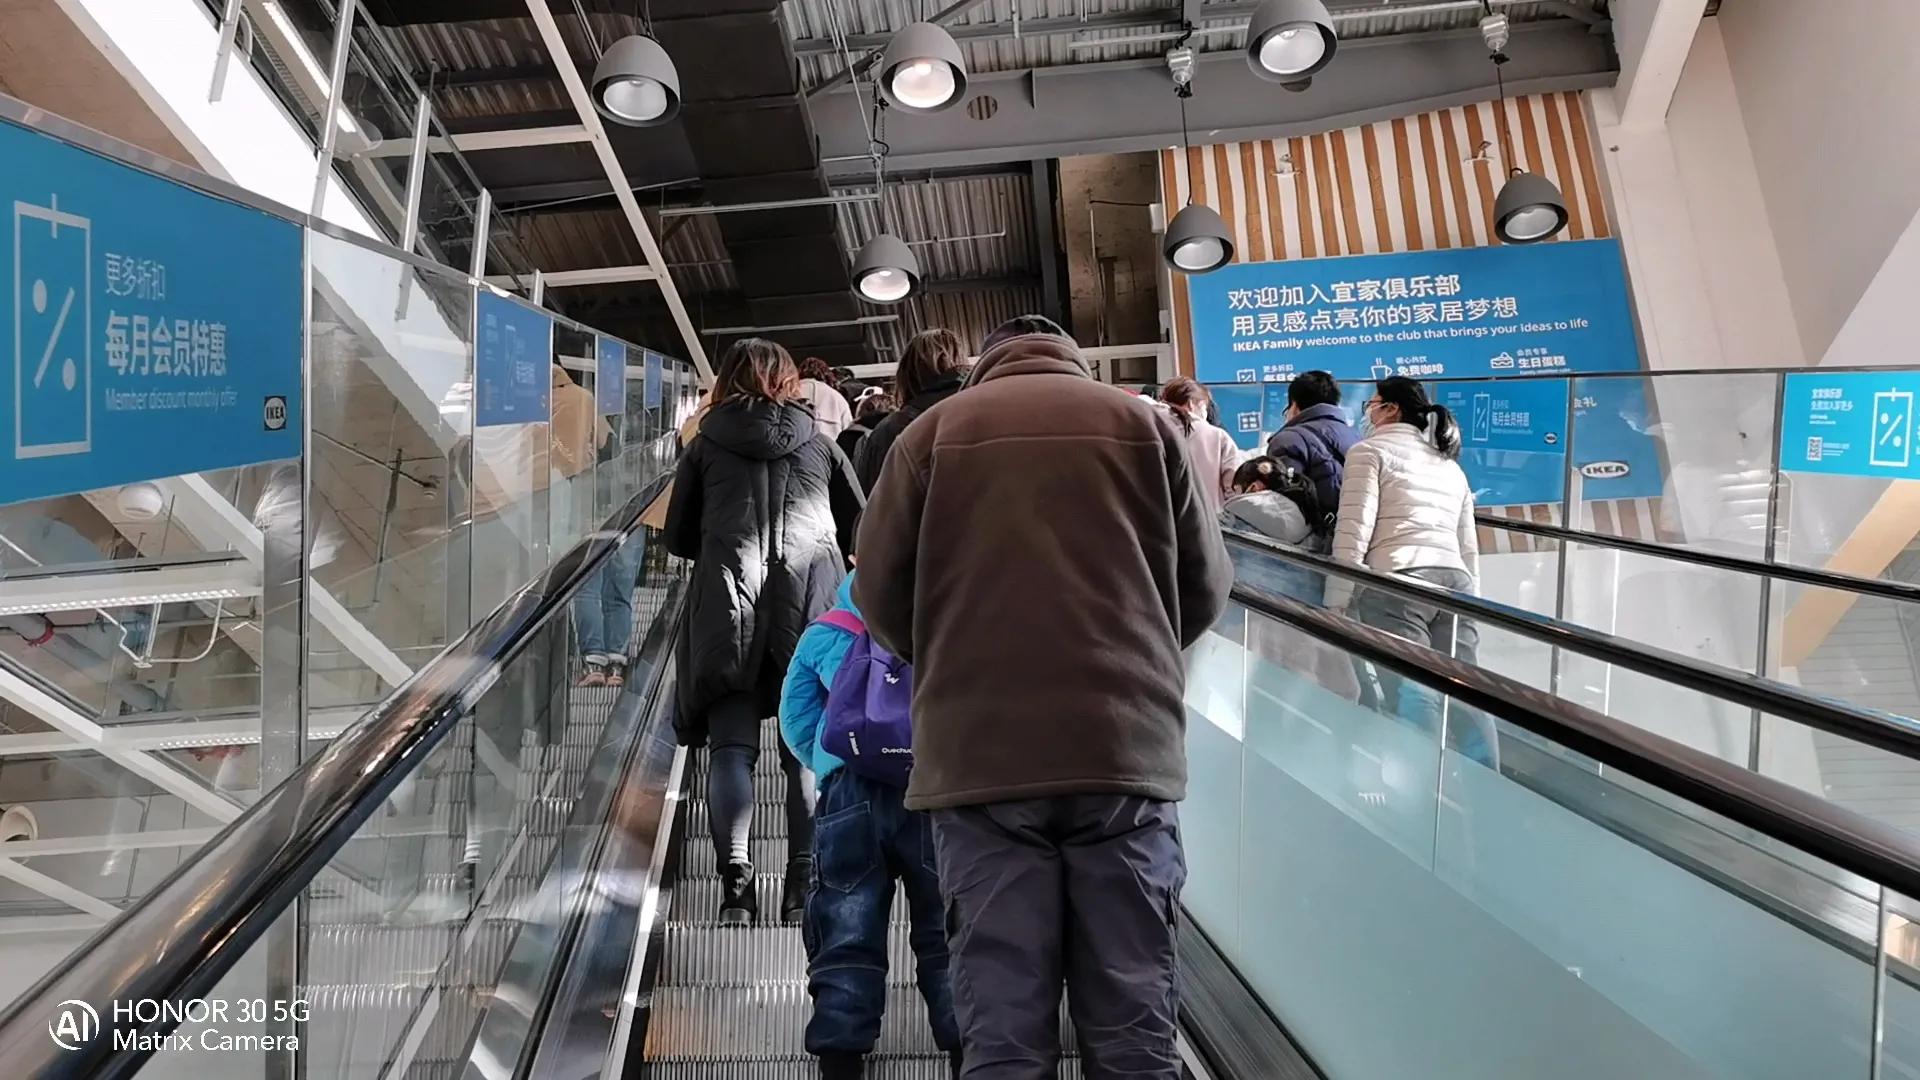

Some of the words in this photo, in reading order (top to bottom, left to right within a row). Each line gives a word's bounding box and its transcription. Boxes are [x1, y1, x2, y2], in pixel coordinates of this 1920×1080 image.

[105, 252, 166, 300] 更多折扣
[1227, 274, 1461, 310] 欢迎加入宜家俱乐部
[1231, 296, 1518, 337] 用灵感点亮你的家居梦想
[105, 310, 227, 377] 每月会员特惠
[1233, 341, 1260, 352] IKEA
[1263, 337, 1303, 350] Family
[1305, 335, 1357, 347] welcome
[1359, 333, 1372, 343] to
[1375, 331, 1393, 342] the
[1396, 328, 1421, 341] club
[1424, 326, 1448, 339] that
[1450, 324, 1488, 338] brings
[1490, 324, 1517, 337] your
[1520, 321, 1552, 334] ideas
[1554, 320, 1568, 330] to
[1570, 318, 1589, 329] life
[1518, 356, 1567, 369] 生日蛋糕
[266, 406, 285, 420] IKEA
[1586, 465, 1626, 474] IKEA
